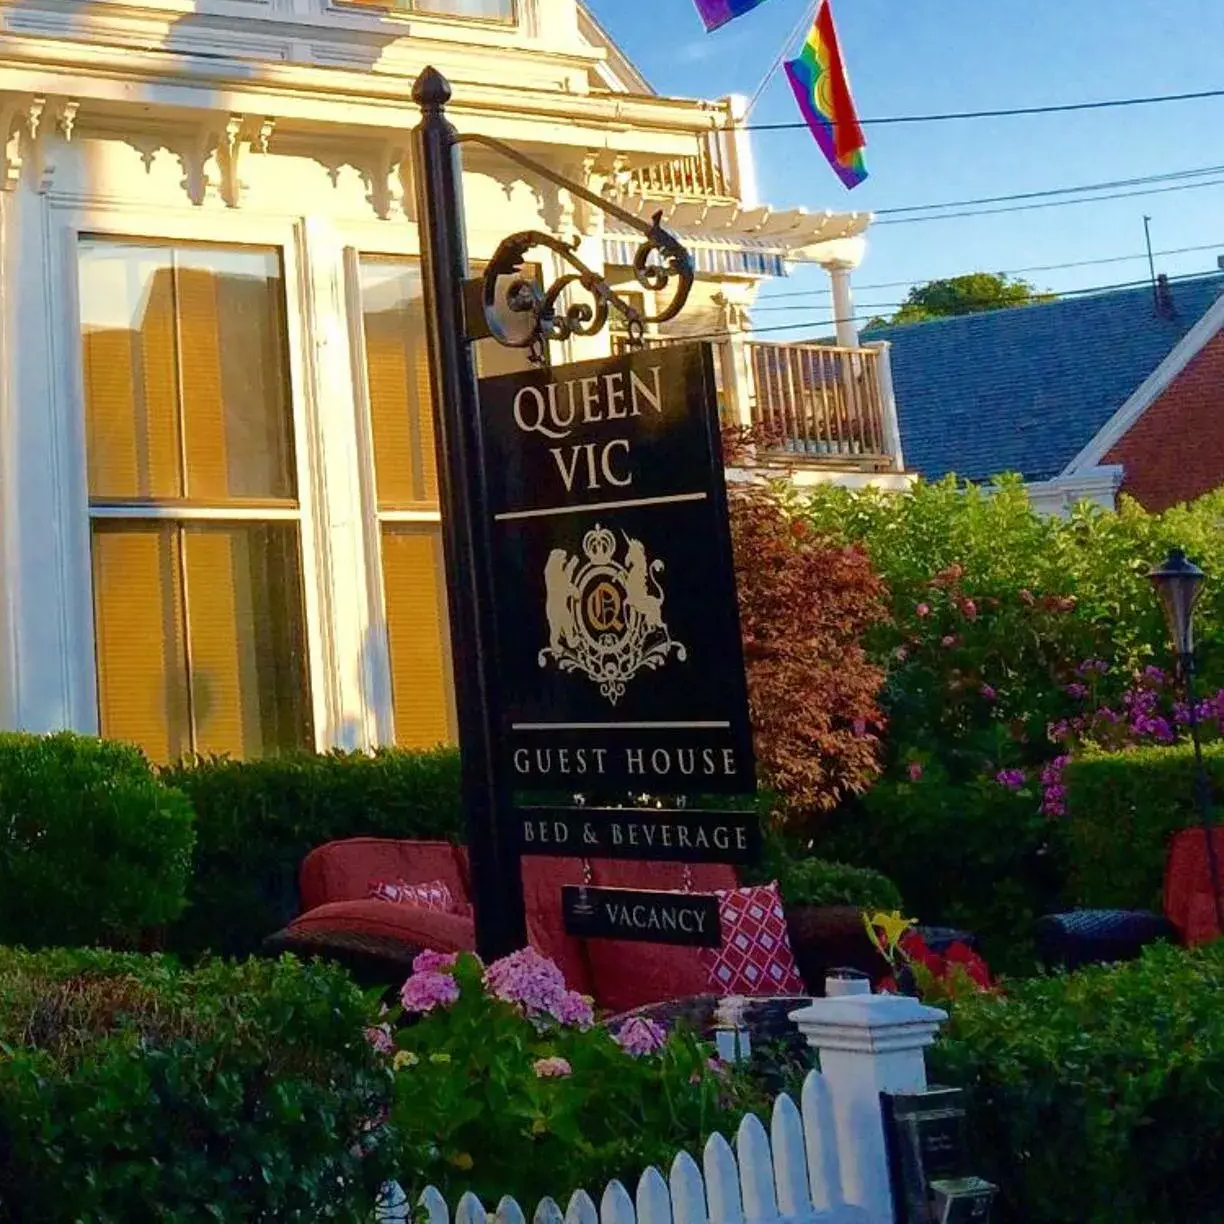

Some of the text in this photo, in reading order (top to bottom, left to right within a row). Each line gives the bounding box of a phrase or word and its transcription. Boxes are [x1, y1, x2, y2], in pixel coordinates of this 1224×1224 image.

[513, 366, 662, 439] QUEEN
[549, 439, 632, 493] VIC
[513, 748, 737, 775] GUEST HOUSE
[524, 821, 747, 849] BED & BEVERAGE
[606, 903, 706, 932] VACANCY
